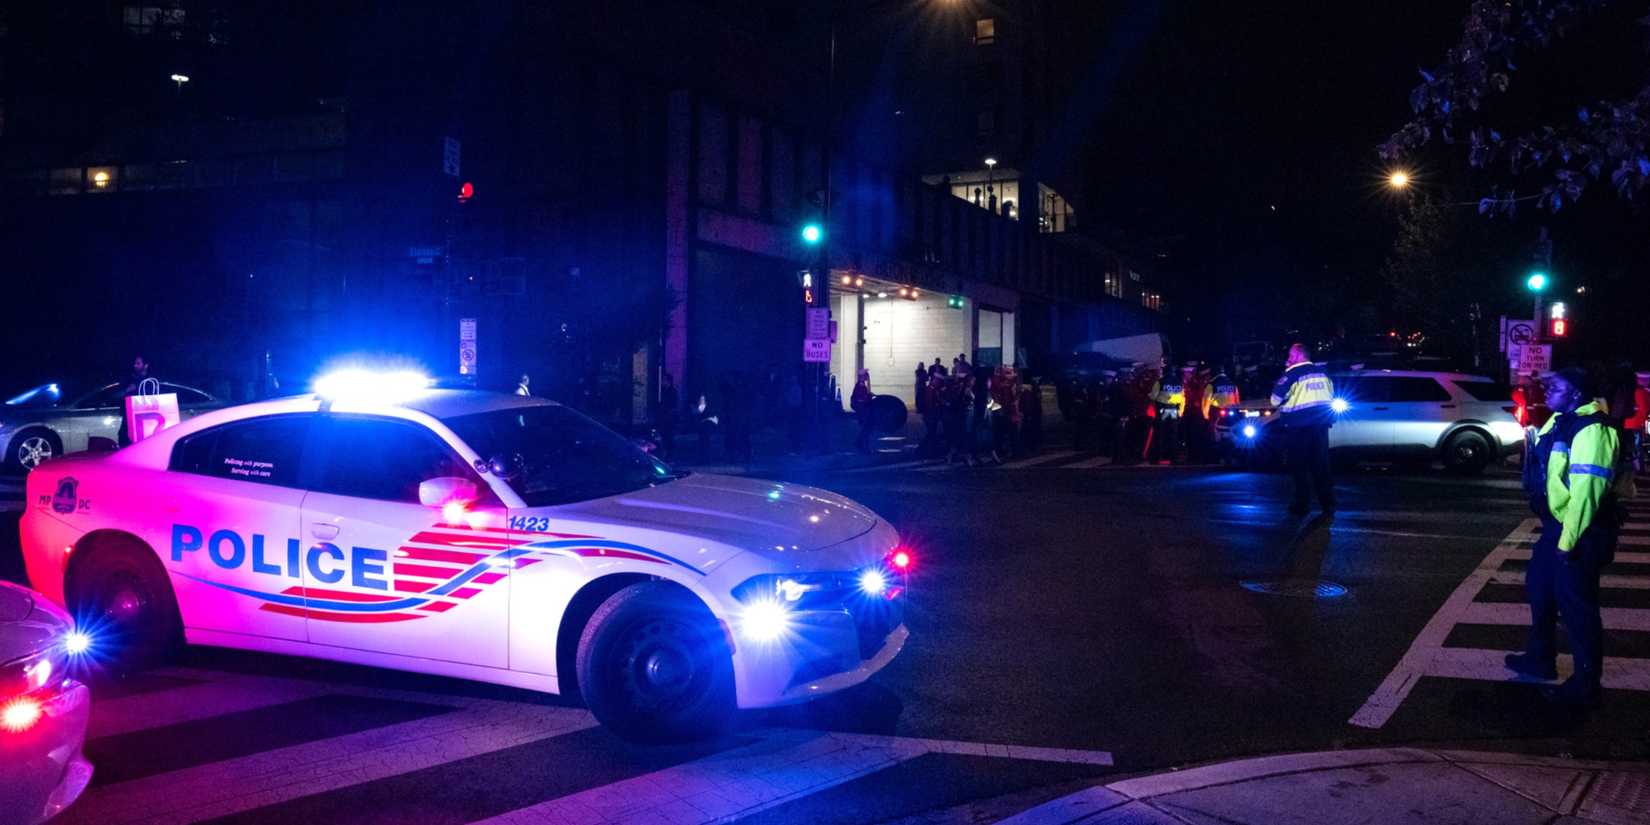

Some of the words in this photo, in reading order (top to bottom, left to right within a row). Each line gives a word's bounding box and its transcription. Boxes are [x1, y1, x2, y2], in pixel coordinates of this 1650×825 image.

[1528, 346, 1543, 354] NO
[224, 457, 243, 467] Policing
[253, 461, 274, 469] purpose
[231, 467, 250, 476] Serving
[509, 516, 550, 531] 1423
[171, 523, 388, 591] POLICE
